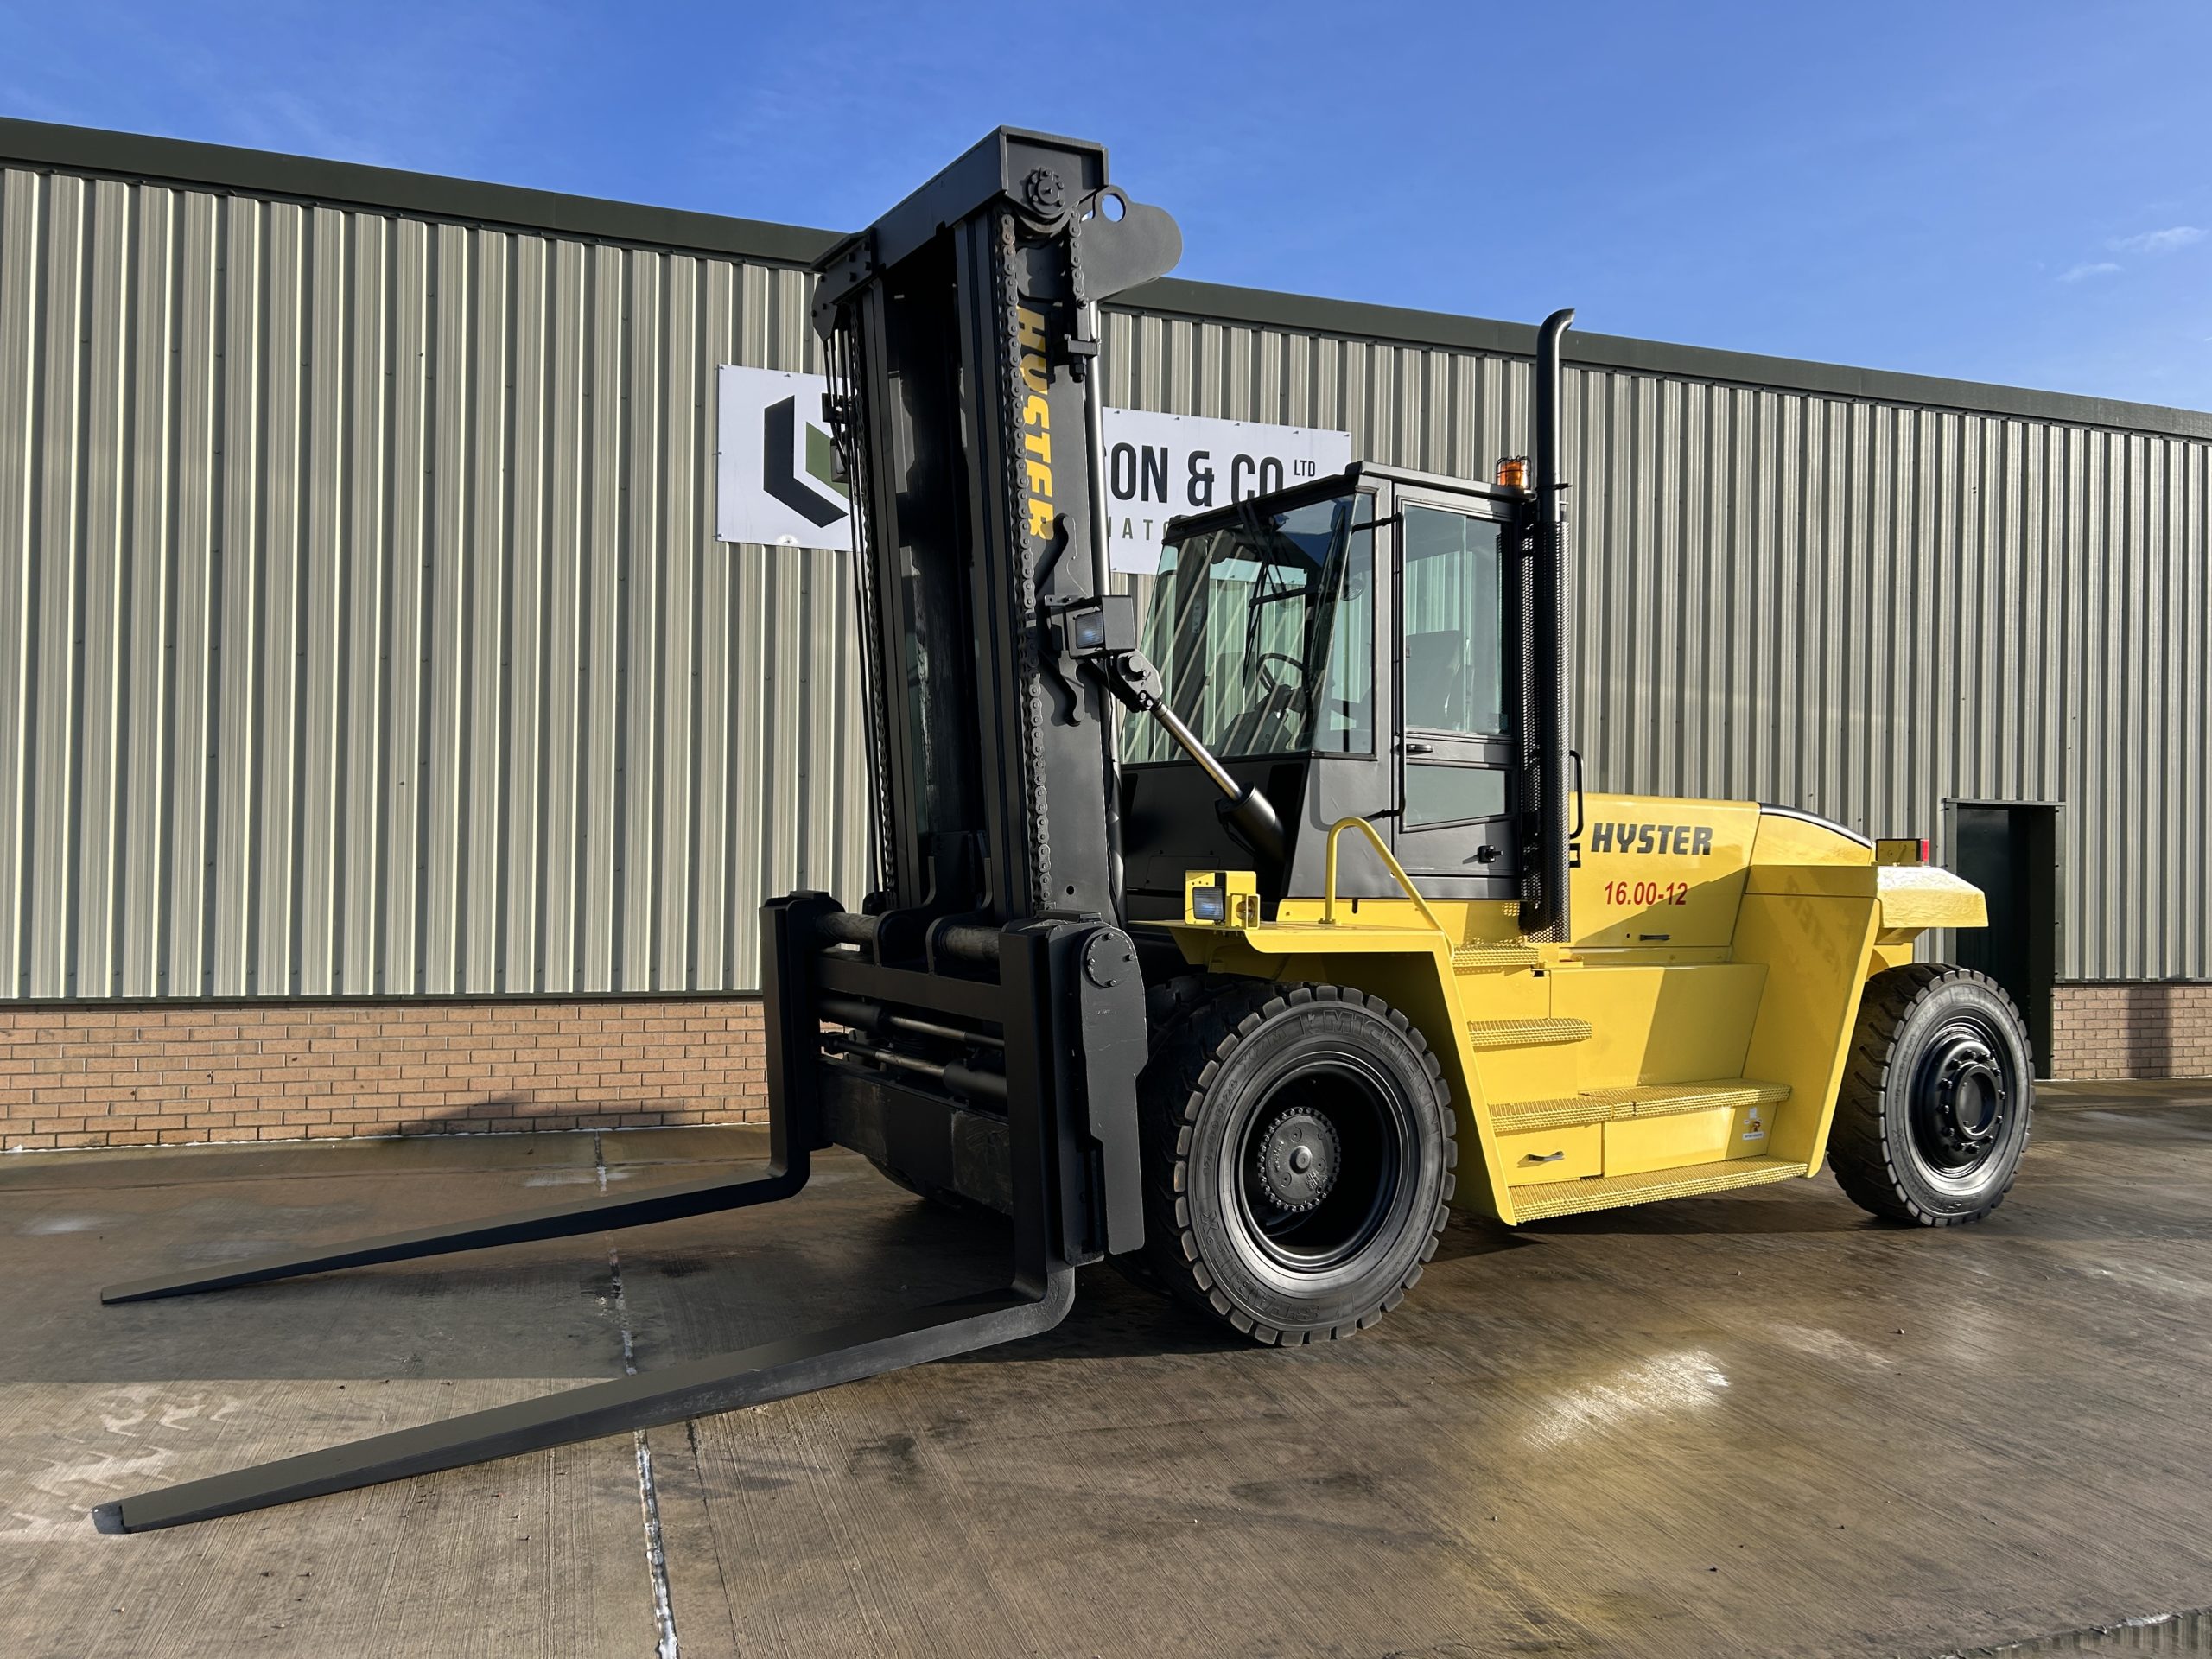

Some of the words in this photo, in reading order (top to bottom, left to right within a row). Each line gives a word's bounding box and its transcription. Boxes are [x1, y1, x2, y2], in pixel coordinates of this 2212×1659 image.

[1103, 442, 1168, 504] ON
[1187, 450, 1214, 507] &
[1230, 454, 1284, 505] CO
[1294, 459, 1315, 477] LTD
[1591, 822, 1713, 855] HYSTER
[1605, 881, 1688, 906] 16.00-12
[1324, 1009, 1440, 1135] MICHELIN
